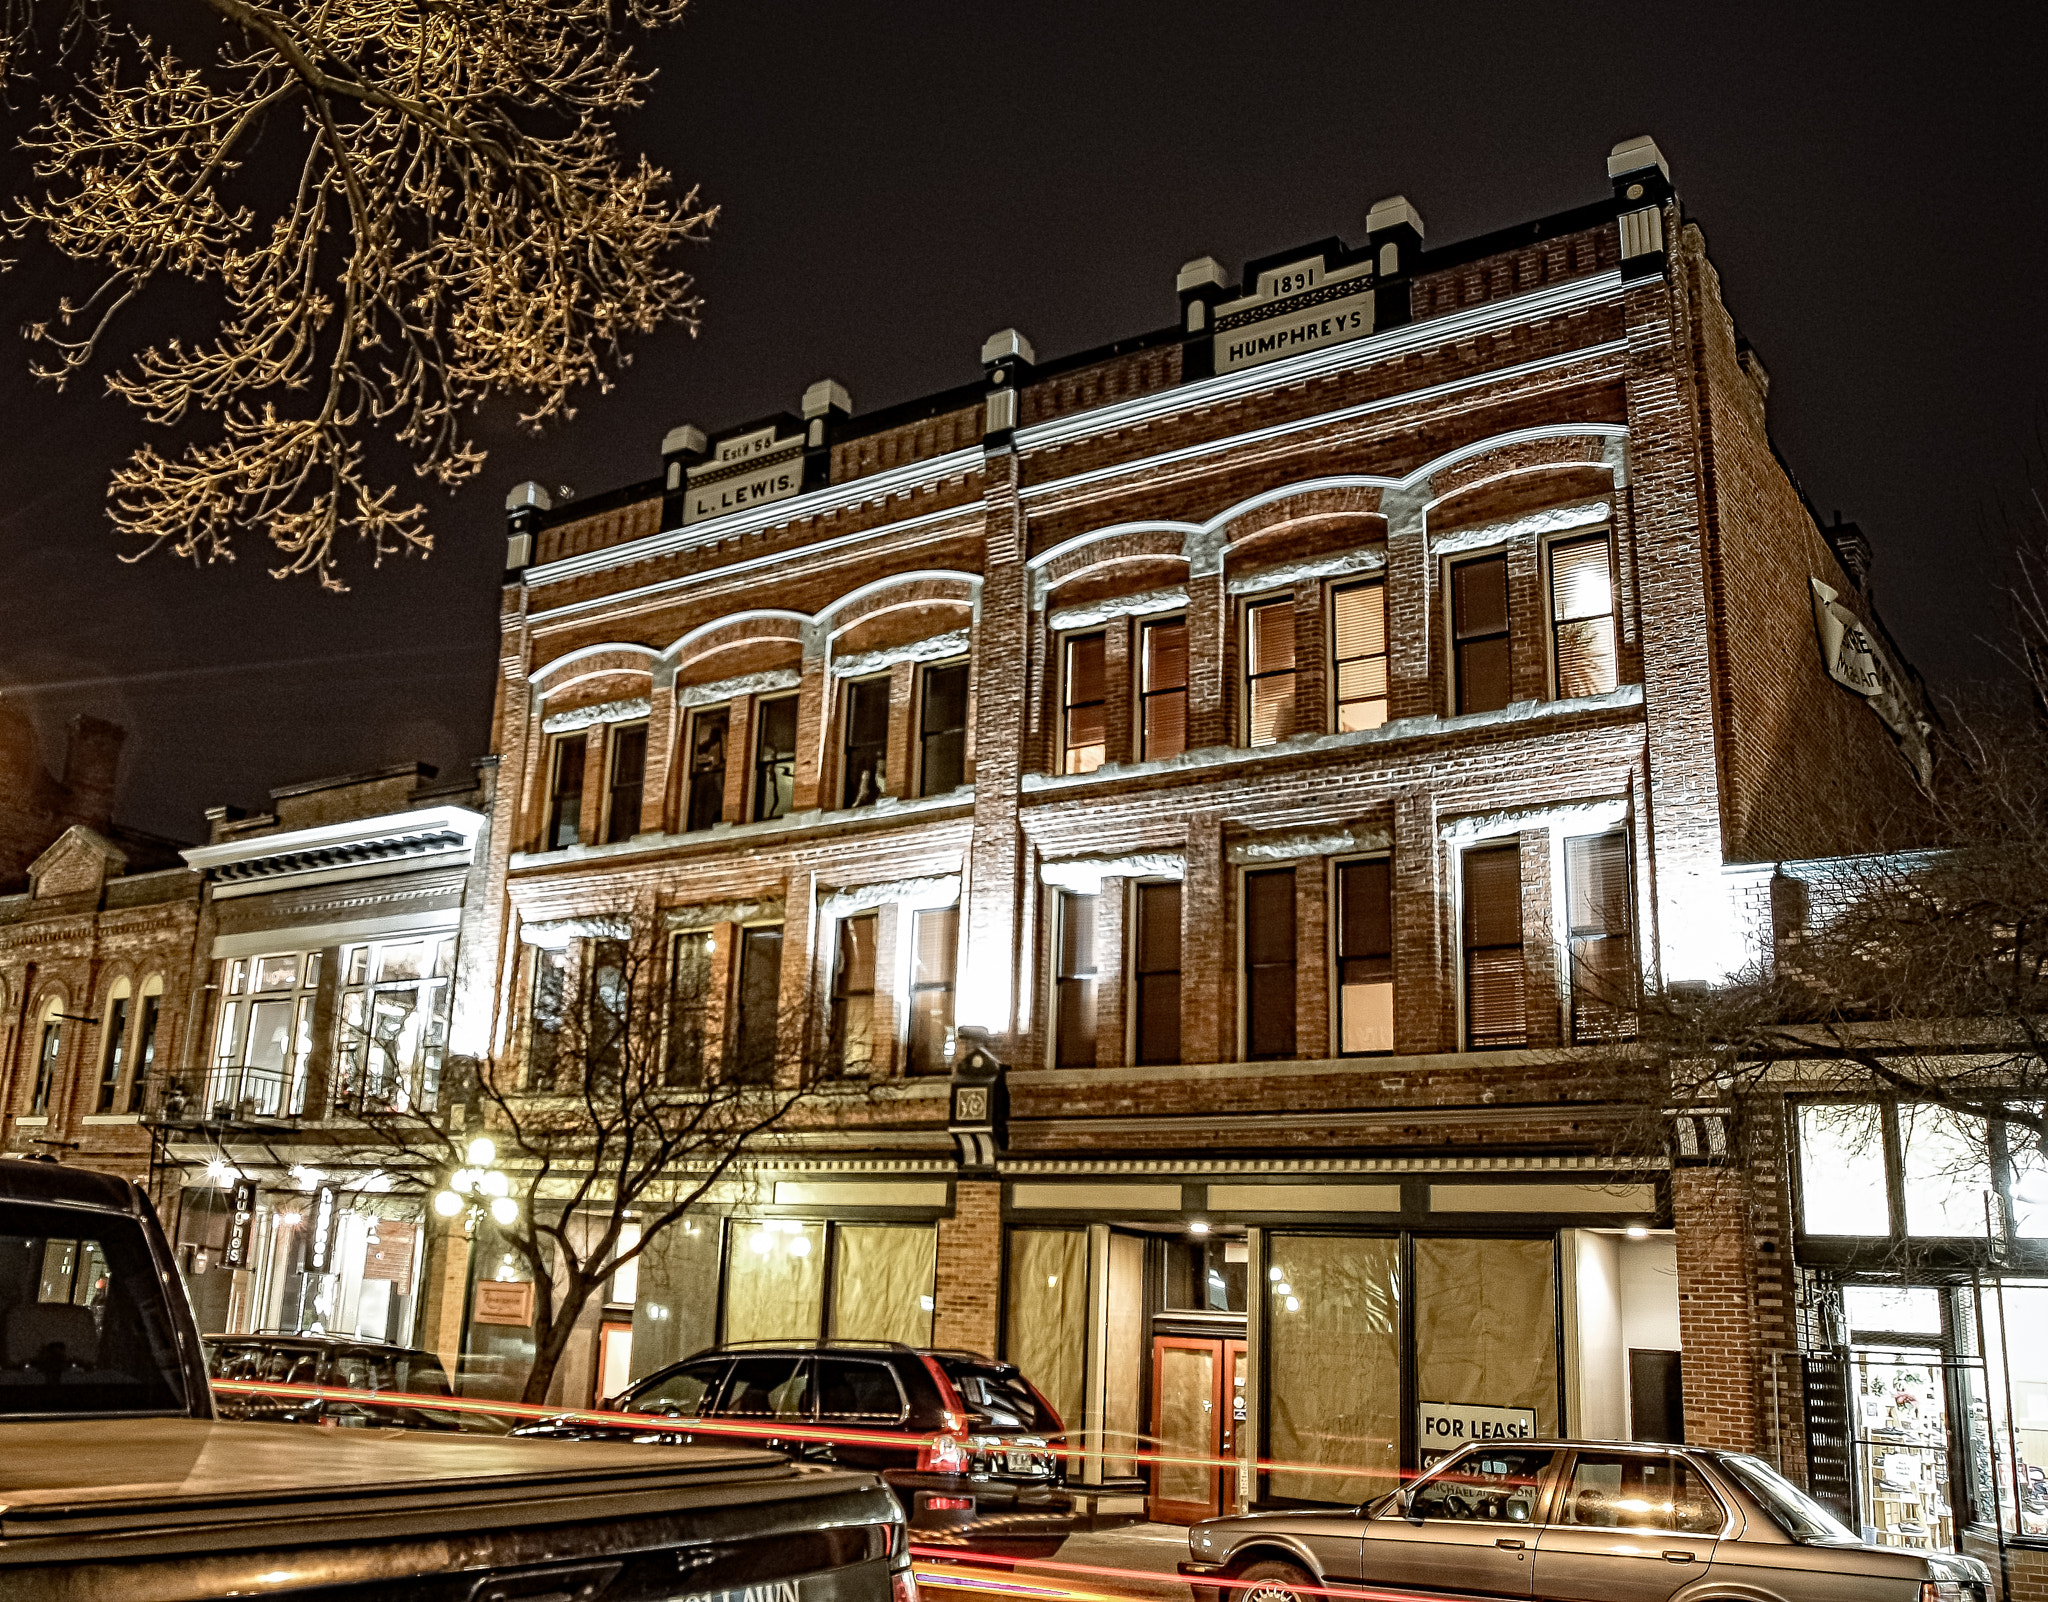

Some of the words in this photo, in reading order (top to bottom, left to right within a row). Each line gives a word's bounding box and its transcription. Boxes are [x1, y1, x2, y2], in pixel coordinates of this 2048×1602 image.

[1274, 268, 1314, 297] 1891
[1229, 311, 1361, 362] HUMPHREYS
[697, 500, 716, 515] L.
[229, 1185, 249, 1262] hughes
[1425, 1416, 1464, 1438] FOR
[1471, 1419, 1529, 1439] LEASE
